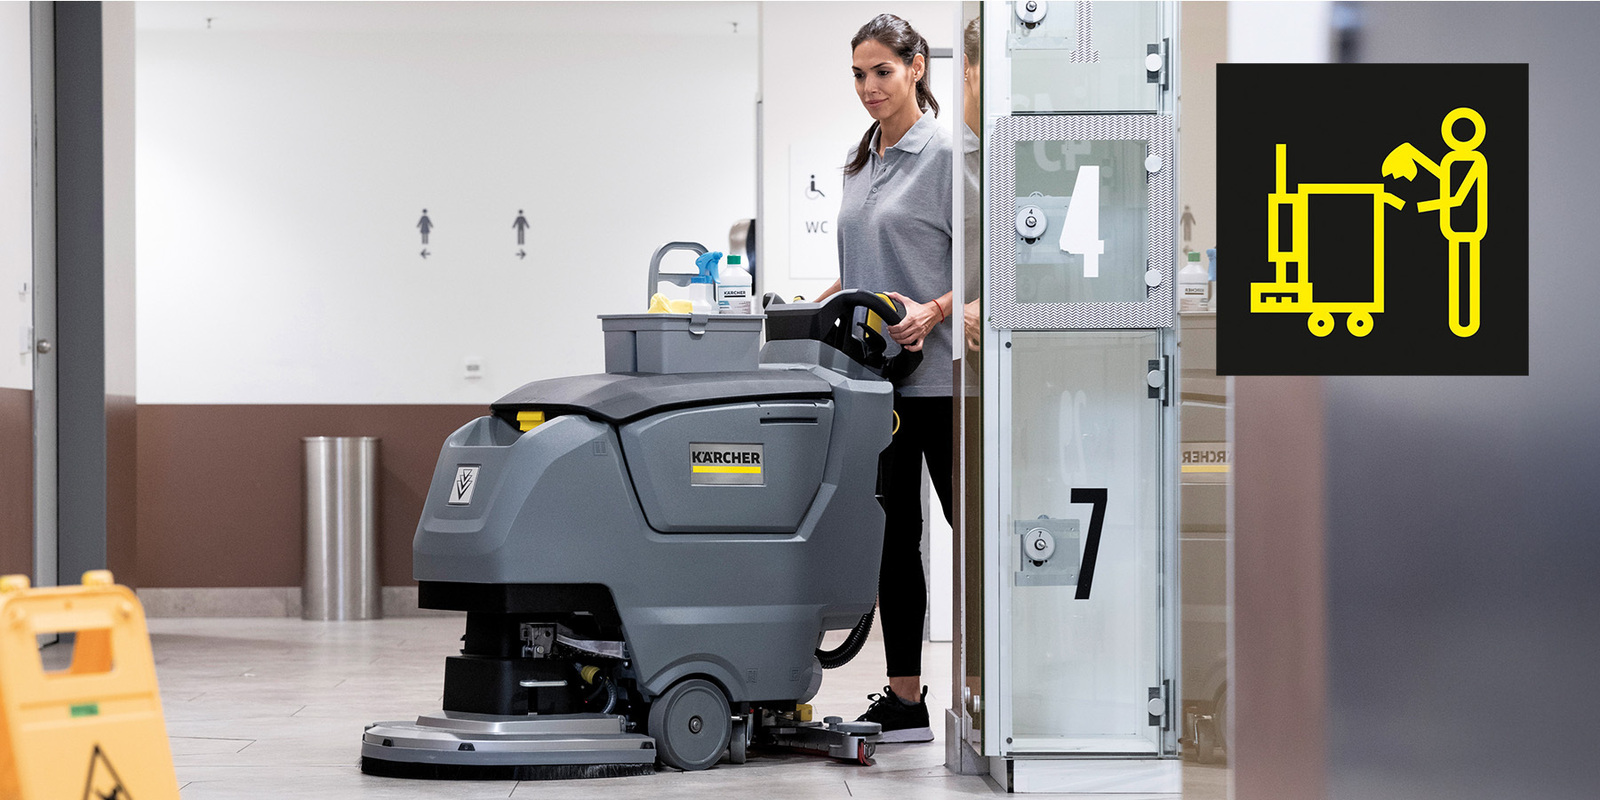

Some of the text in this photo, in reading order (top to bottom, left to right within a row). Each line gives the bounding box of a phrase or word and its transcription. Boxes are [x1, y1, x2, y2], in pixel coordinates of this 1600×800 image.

[805, 221, 829, 234] WC
[1059, 165, 1105, 278] 4
[691, 451, 761, 464] KÄRCHER
[1070, 488, 1108, 600] 7
